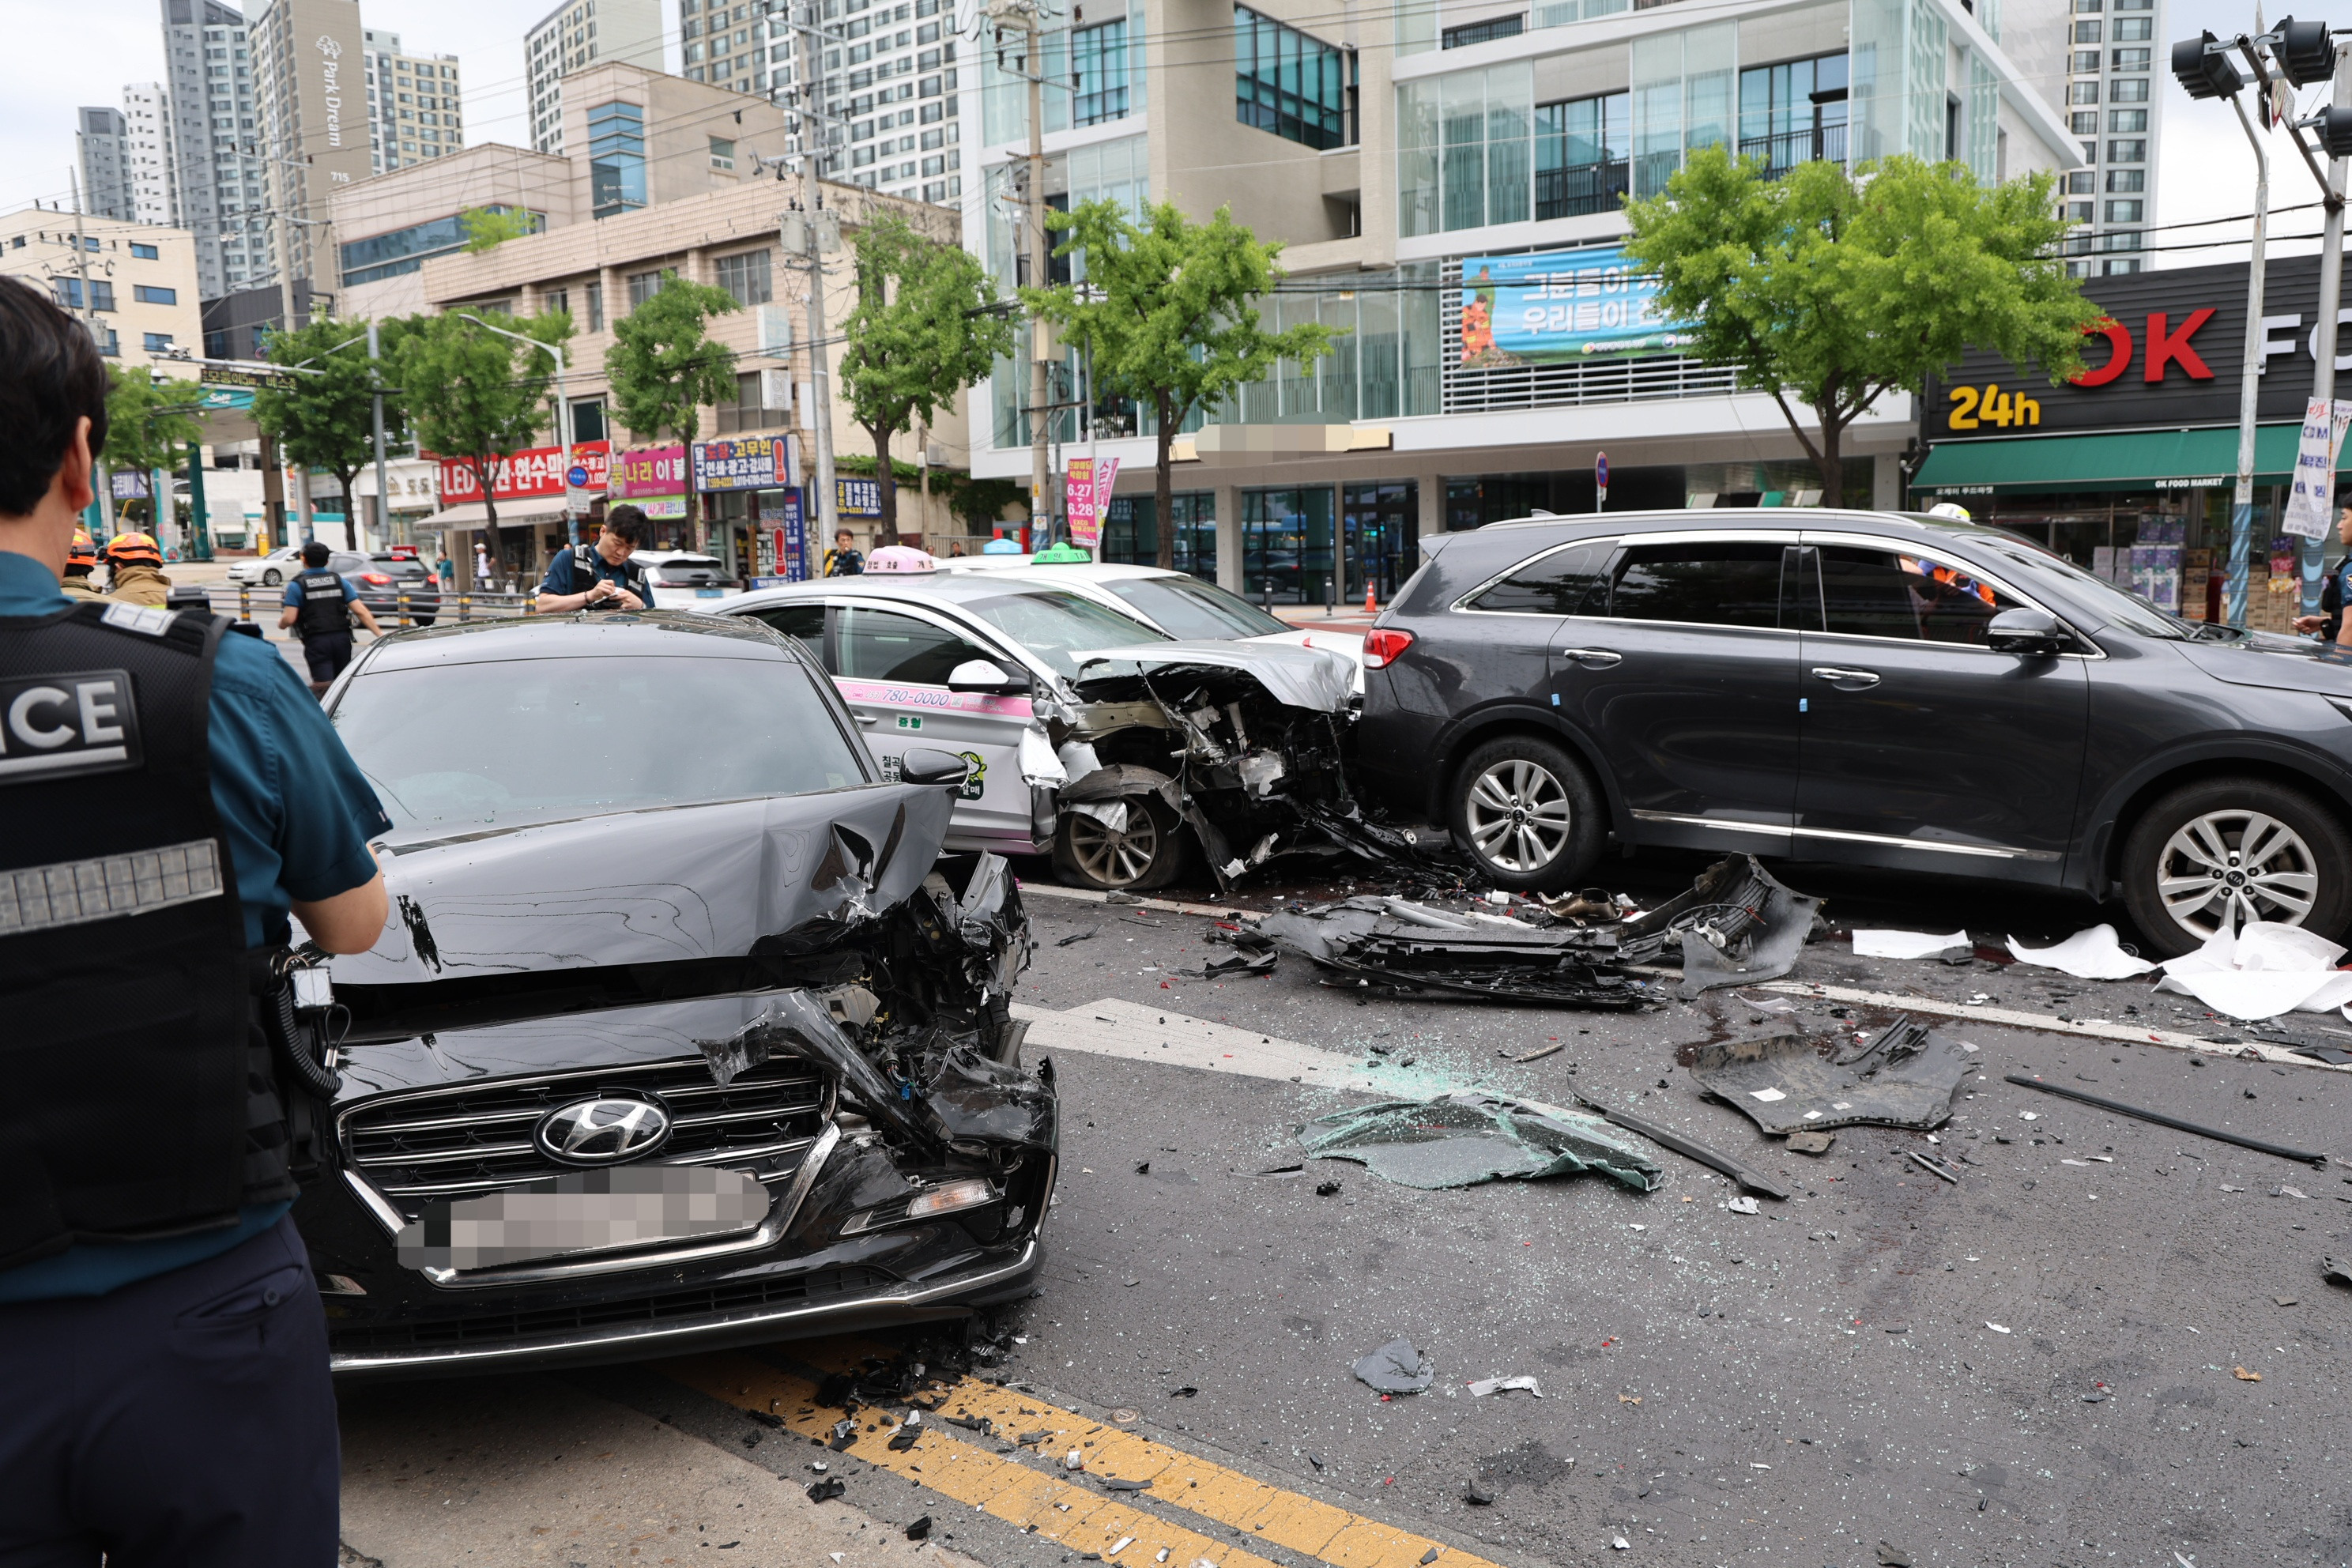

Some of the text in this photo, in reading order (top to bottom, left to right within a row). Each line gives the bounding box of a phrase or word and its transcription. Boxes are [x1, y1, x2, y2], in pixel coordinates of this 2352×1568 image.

[322, 61, 341, 147] Park Dream
[331, 172, 349, 183] 715
[1522, 265, 1630, 301] 그분들이
[1522, 300, 1629, 335] 우리들이
[2067, 307, 2217, 387] OK
[1948, 383, 2040, 430] 24h
[443, 463, 476, 496] LED
[2154, 477, 2224, 488] OK FOOD MARKET
[1067, 483, 1092, 497] 6.27
[1936, 485, 1995, 496] 오케이 푸드마켓
[1068, 502, 1094, 516] 6.28
[306, 575, 336, 585] POLICE
[882, 688, 950, 707] 780-0000
[882, 756, 900, 768] 칠곡
[2228, 873, 2243, 885] KIA
